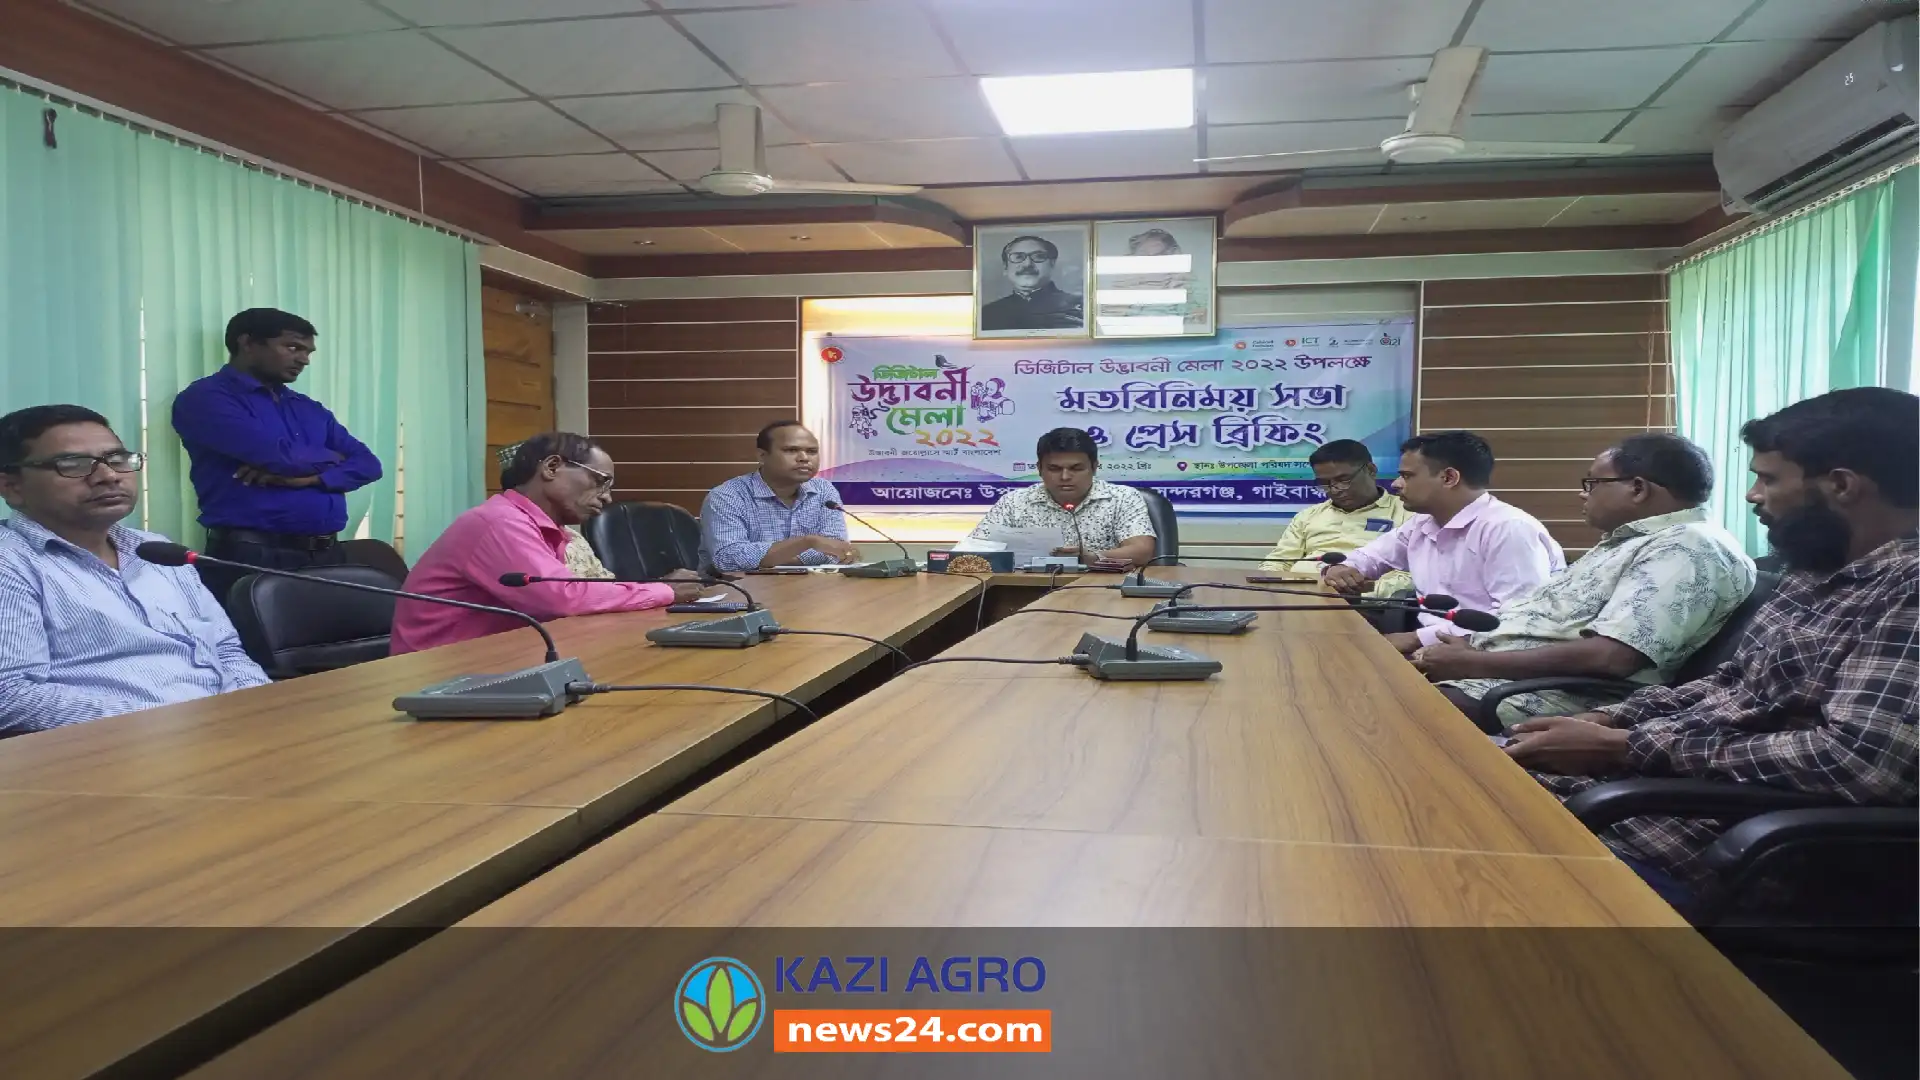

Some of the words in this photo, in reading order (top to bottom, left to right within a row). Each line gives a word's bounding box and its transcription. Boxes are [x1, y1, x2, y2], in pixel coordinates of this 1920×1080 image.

[872, 365, 940, 382] ডিজিটাল
[1014, 360, 1094, 375] ডিজিটাল
[1100, 357, 1172, 375] উদ্ভাবনী
[1177, 359, 1224, 373] মেলা
[1232, 357, 1287, 372] ২০২২
[1294, 353, 1373, 369] উপলক্ষে
[847, 365, 975, 405] উদ্ভাবনী
[1056, 380, 1257, 412] মতবিনিময়
[1270, 382, 1347, 407] সভা
[885, 404, 967, 435] মেলা
[915, 428, 1000, 448] ২০২২
[1125, 419, 1198, 449] প্রেস
[1212, 414, 1324, 448] ব্রিফিং
[1107, 463, 1135, 471] ২০২২
[871, 485, 972, 500] আয়োজনেঃ
